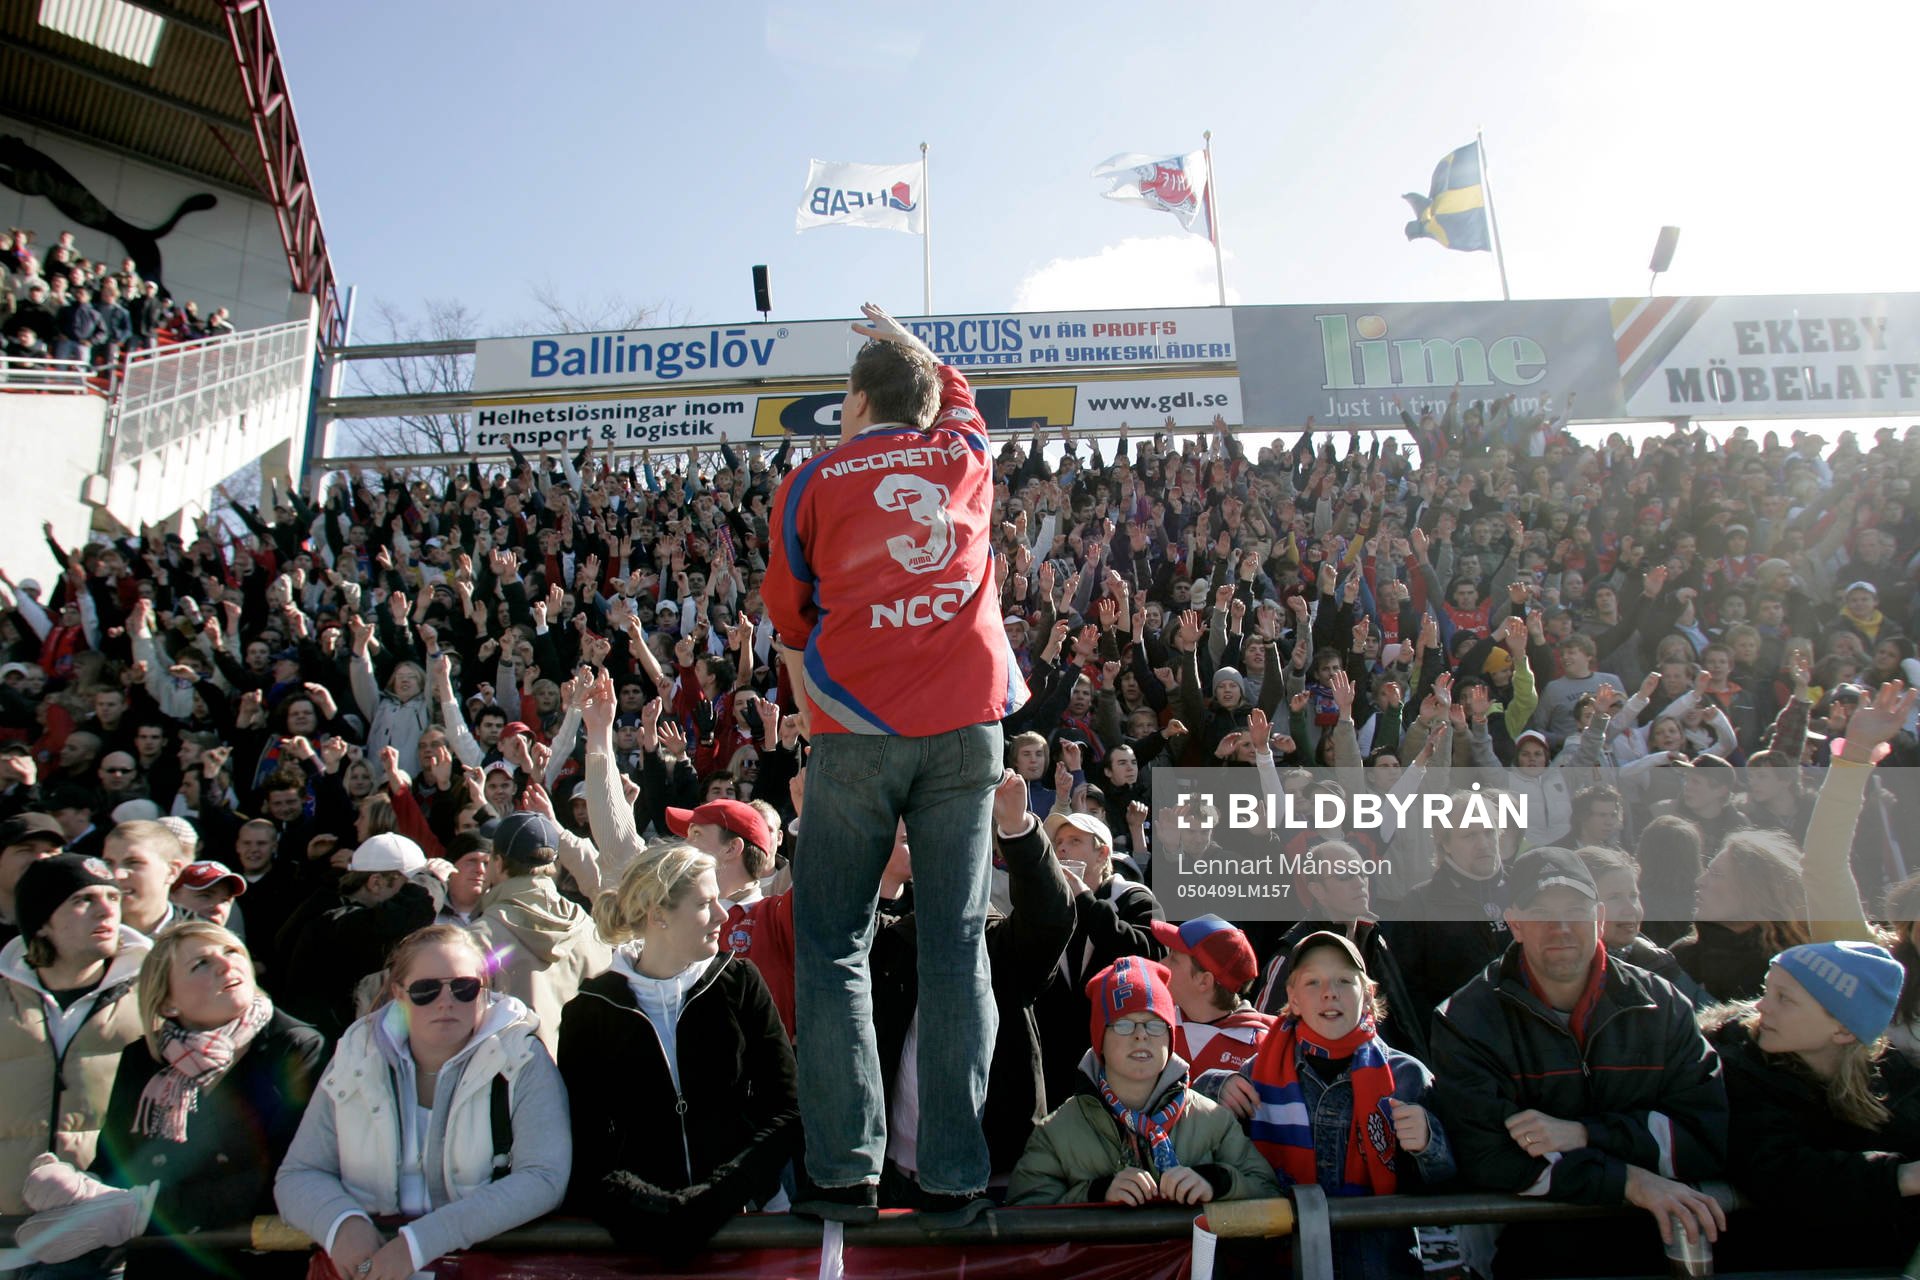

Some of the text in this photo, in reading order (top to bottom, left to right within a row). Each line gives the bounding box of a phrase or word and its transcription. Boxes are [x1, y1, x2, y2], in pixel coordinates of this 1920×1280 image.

[868, 319, 1023, 354] ERCUS
[1029, 320, 1177, 340] VI ÄR PROFFS
[1733, 316, 1888, 356] EKEBY
[1066, 341, 1231, 362] YRKESKLÄDER!
[1314, 314, 1547, 390] lime
[478, 400, 744, 427] Helhetslösningar inom
[1087, 391, 1229, 414] www.gdl.se
[1325, 397, 1371, 417] Just
[1409, 394, 1461, 416] tim
[477, 420, 714, 448] transport & logistik
[821, 440, 969, 480] NICORETTE
[873, 473, 958, 574] 3
[869, 592, 962, 629] NCC
